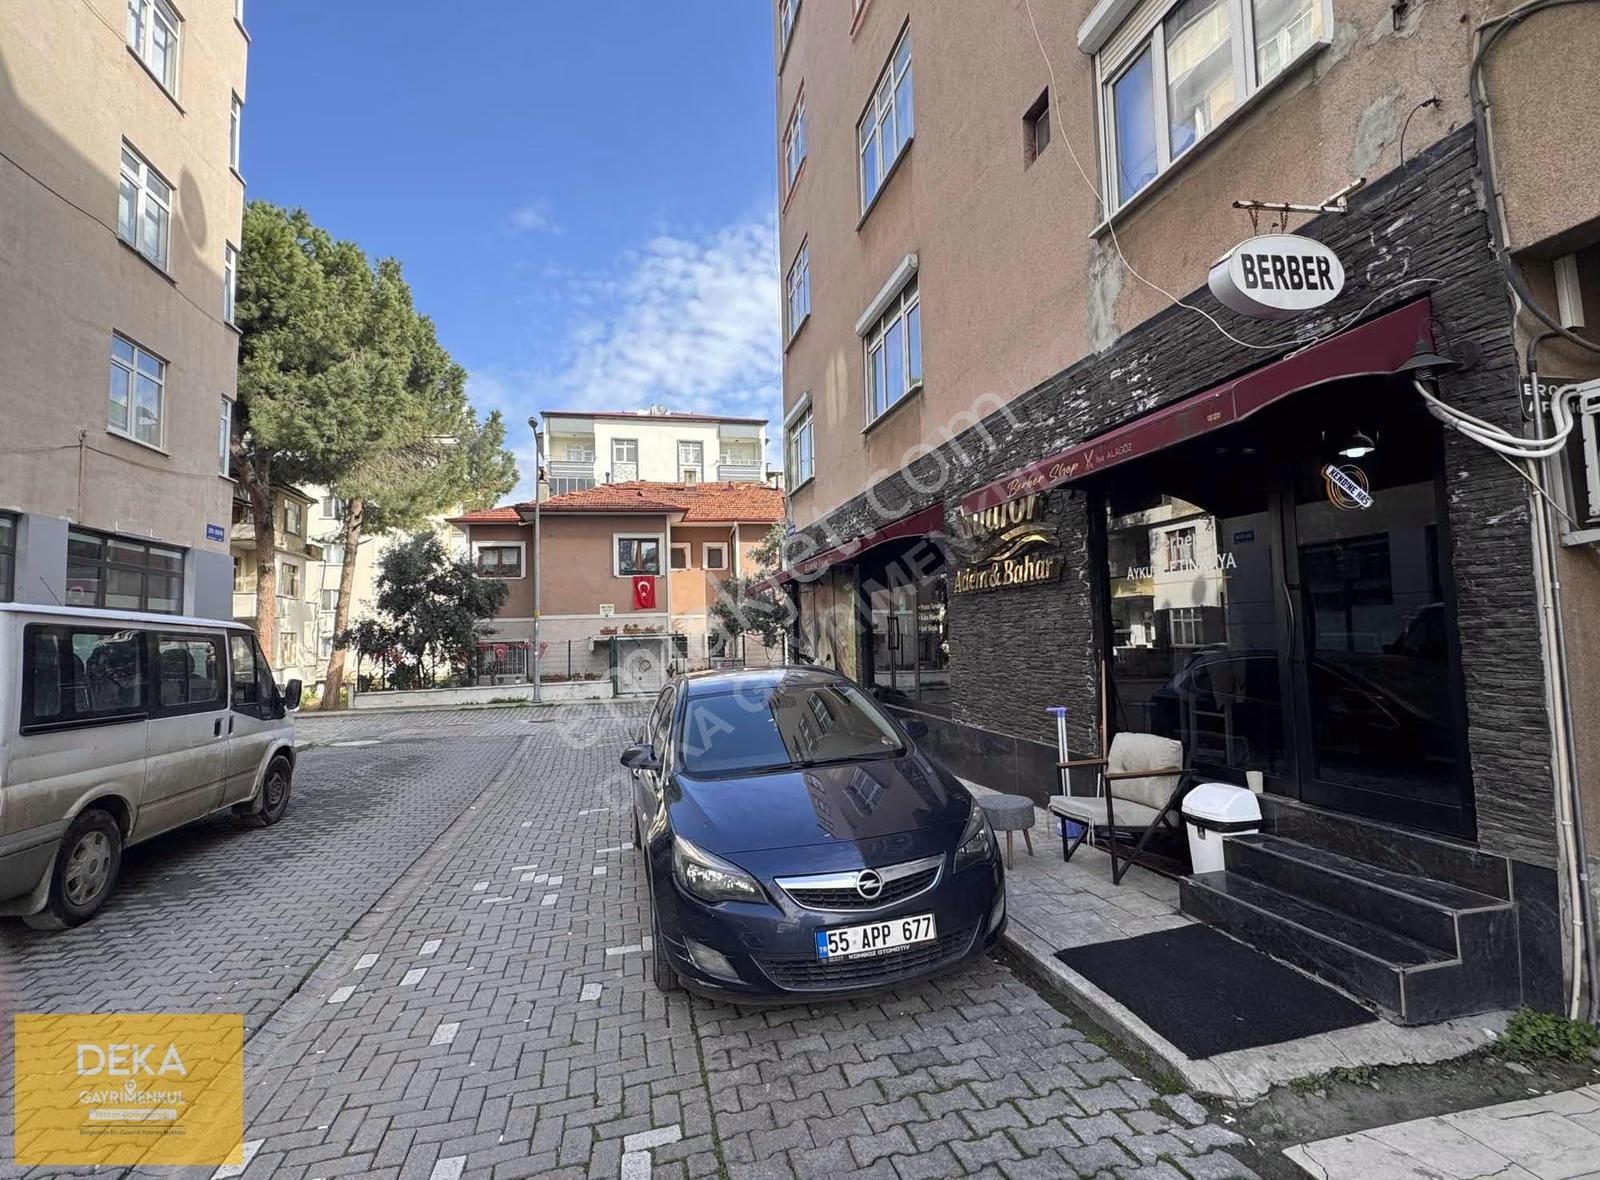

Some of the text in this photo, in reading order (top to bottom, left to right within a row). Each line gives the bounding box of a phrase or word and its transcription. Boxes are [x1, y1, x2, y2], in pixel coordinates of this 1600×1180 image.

[1240, 253, 1335, 291] BERBER
[1006, 461, 1079, 499] Berber Shop
[1002, 555, 1054, 585] Bahar
[828, 917, 931, 953] 55 APP 677
